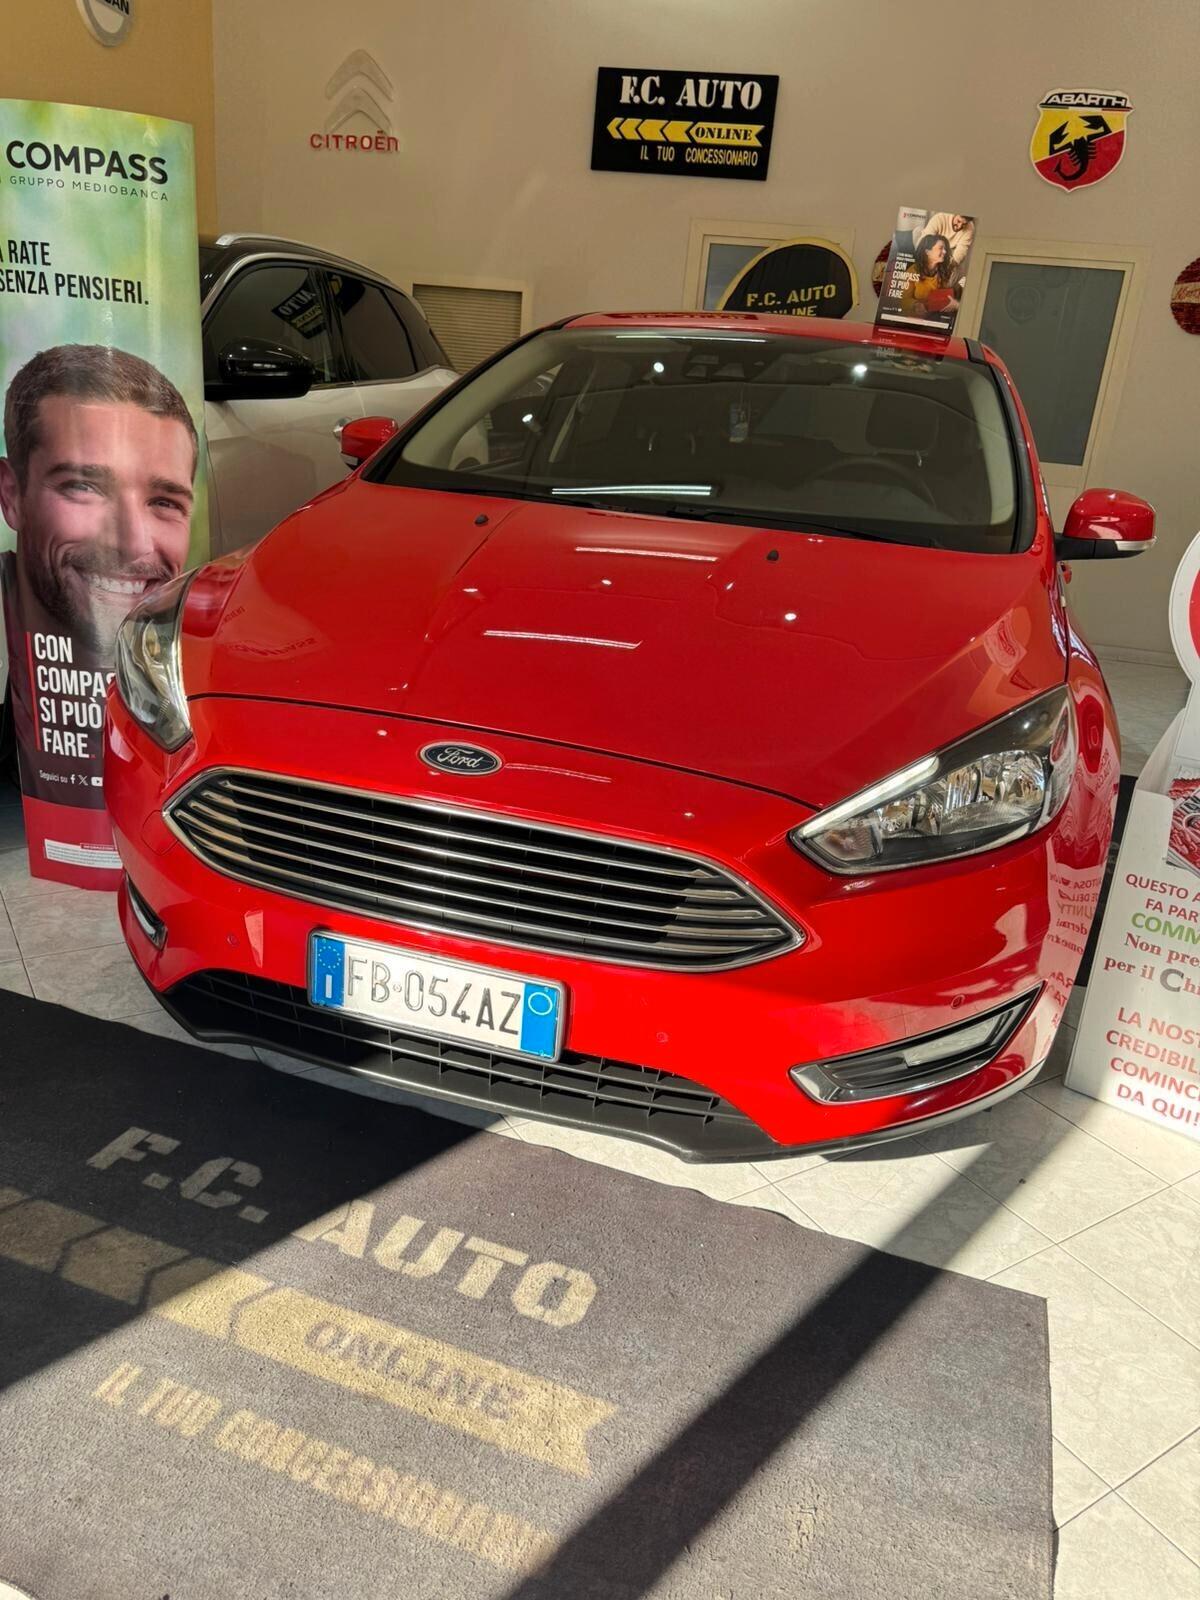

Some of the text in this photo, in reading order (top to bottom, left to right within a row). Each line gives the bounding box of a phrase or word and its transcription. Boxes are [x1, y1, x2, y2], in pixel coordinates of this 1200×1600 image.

[675, 78, 763, 111] AUTO
[1047, 93, 1126, 107] ABARTH
[694, 126, 753, 142] ONLINE
[5, 139, 169, 185] COMPASS
[640, 145, 759, 167] IL TUO CONCESSIONARIO
[9, 175, 169, 202] GRUPPO MEDIOBANCA
[7, 239, 52, 267] RATE
[894, 261, 907, 270] CON
[0, 268, 150, 306] SENZA PENSIERI.
[892, 270, 920, 282] COMPASS
[746, 284, 836, 307] F.C. AUTO
[34, 632, 73, 664] CON
[40, 696, 103, 729] SI PUÒ
[436, 746, 484, 768] Ford
[1126, 873, 1189, 900] QUESTO
[1145, 898, 1200, 923] FA PAR
[1131, 912, 1200, 945] COMM
[1124, 932, 1162, 956] Non
[1103, 956, 1136, 974] per
[1140, 964, 1155, 981] il
[1117, 1006, 1142, 1028] LA
[1117, 1083, 1200, 1126] DA QUI!
[86, 1126, 598, 1328] F.C. AUTO
[303, 1319, 525, 1421] ONLINE
